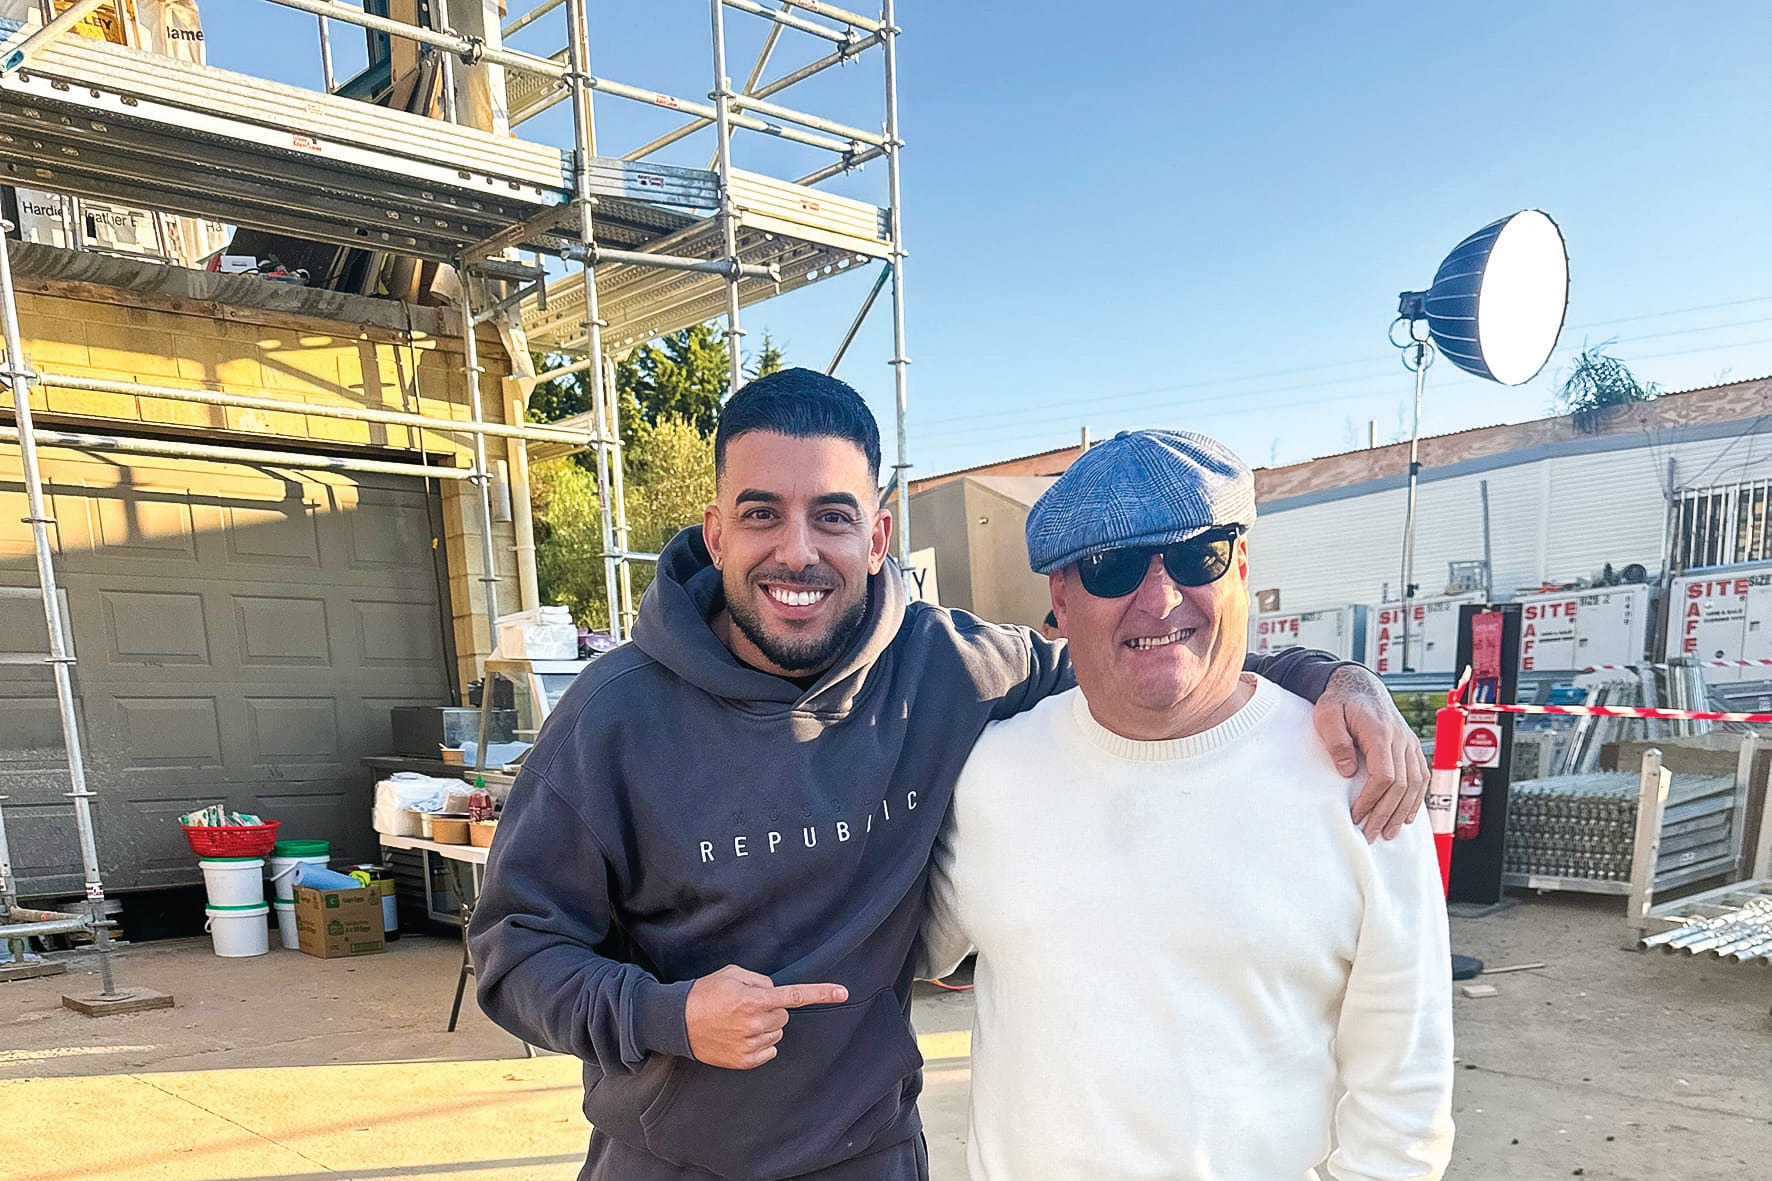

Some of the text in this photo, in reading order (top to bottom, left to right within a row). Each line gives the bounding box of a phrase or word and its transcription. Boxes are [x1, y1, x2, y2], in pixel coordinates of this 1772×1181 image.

[1687, 578, 1748, 599] SITE
[1524, 601, 1577, 620] SITE
[1258, 618, 1299, 635] SITE
